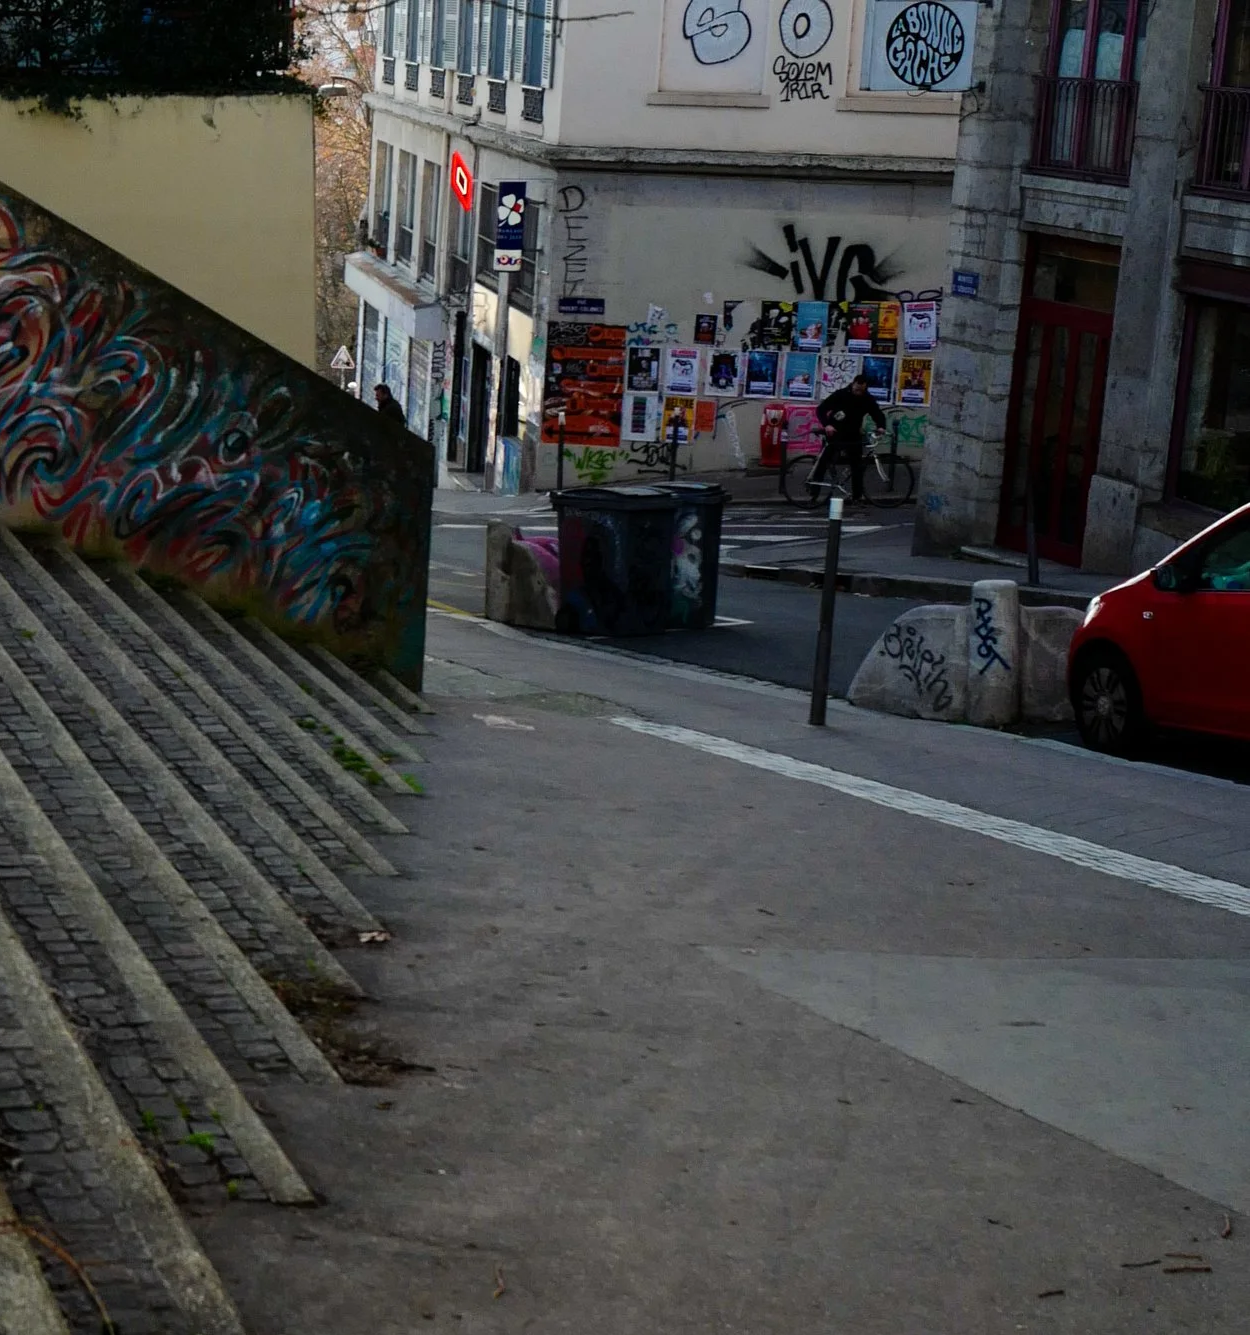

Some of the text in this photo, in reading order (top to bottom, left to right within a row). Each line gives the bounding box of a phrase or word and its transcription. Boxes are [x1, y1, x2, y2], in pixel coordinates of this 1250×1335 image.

[892, 3, 962, 54] LA BONNE
[888, 35, 956, 85] GÂCHE
